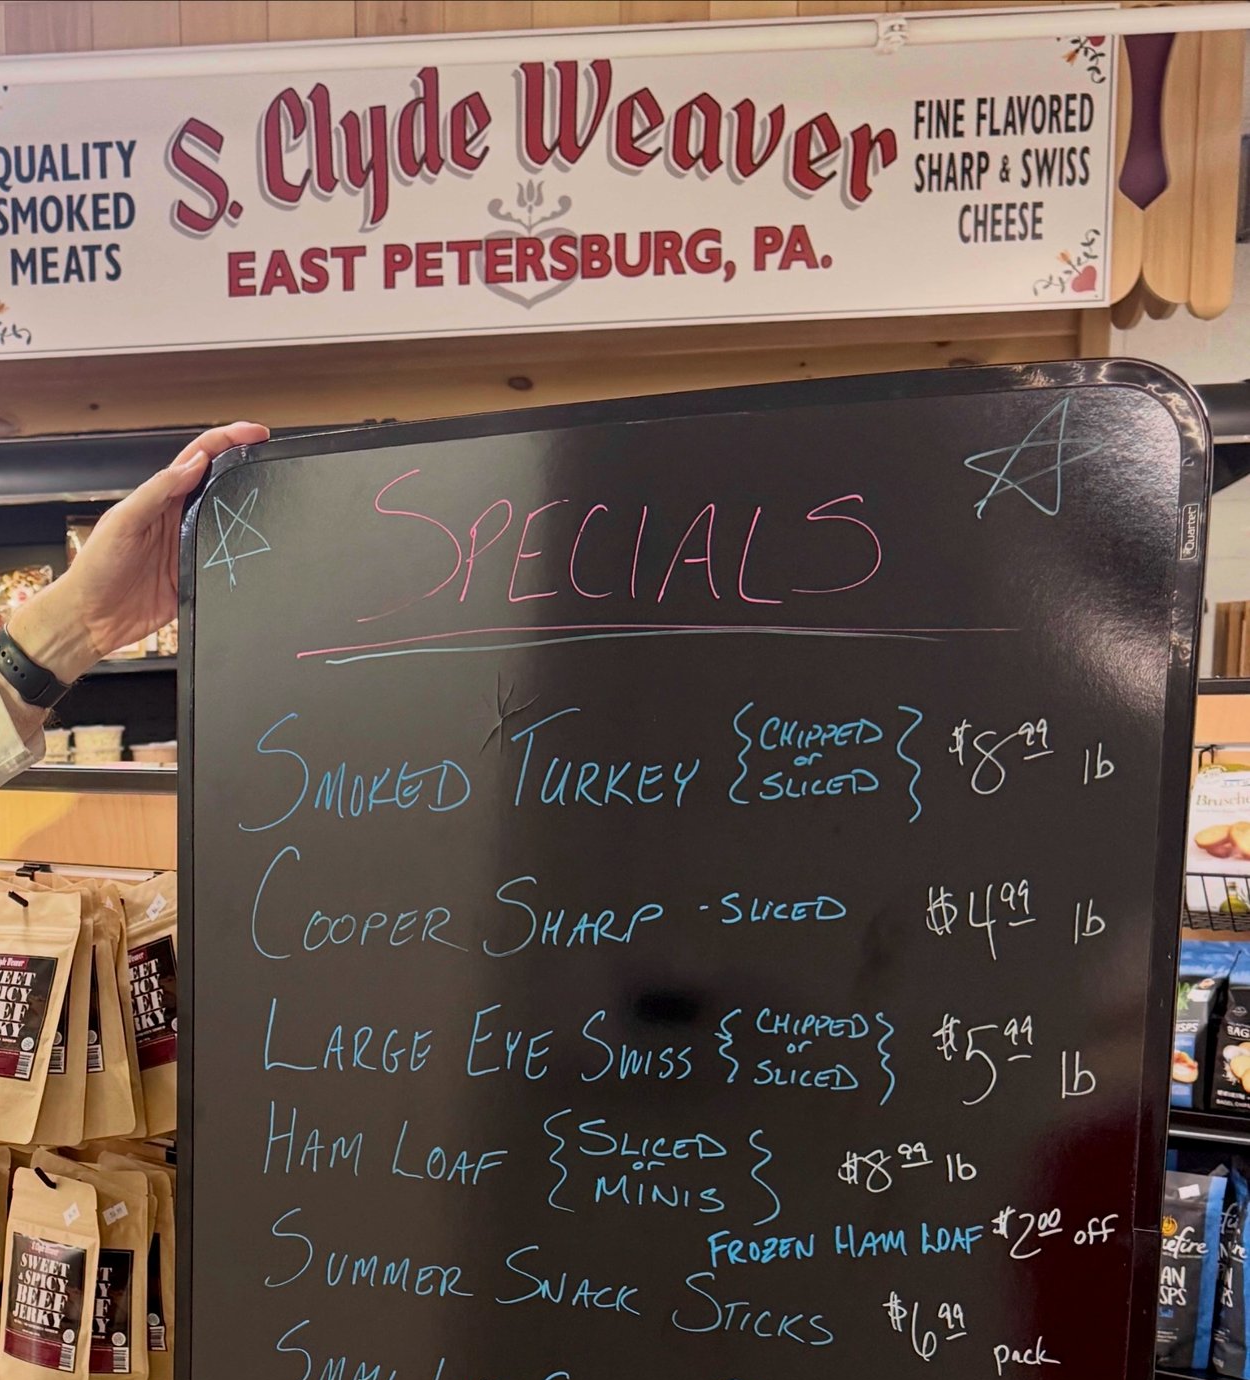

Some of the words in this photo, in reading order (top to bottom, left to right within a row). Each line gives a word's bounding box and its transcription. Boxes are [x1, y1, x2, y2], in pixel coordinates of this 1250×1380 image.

[914, 98, 966, 140] FINE
[975, 92, 1095, 138] FLAVORED
[169, 116, 244, 235] S.
[261, 65, 493, 227] Clyde
[518, 58, 899, 203] Weaver
[914, 151, 991, 193] SHARP
[998, 154, 1011, 184] &
[1020, 147, 1093, 188] SWISS
[957, 201, 1044, 244] CHEESE
[10, 243, 123, 287] MEATS
[227, 245, 367, 298] EAST
[383, 228, 737, 291] PETERSBURG,
[753, 224, 834, 272] PA.
[357, 469, 882, 622] SPECIALS
[759, 716, 884, 751] CHIPPED
[238, 712, 471, 832] SMOKED
[511, 708, 699, 807] TURKEY
[793, 750, 823, 767] or
[759, 768, 880, 800] SLICED
[252, 845, 469, 959] COOPER
[482, 875, 664, 958] SHARP
[264, 998, 433, 1074] LARGE
[467, 1004, 554, 1081] EYE
[581, 1010, 693, 1083] SWISS
[756, 1007, 870, 1038] CHIPPED
[1226, 1025, 1250, 1039] BAG
[786, 1040, 813, 1055] or
[754, 1060, 859, 1091] SLICED
[263, 1100, 364, 1177] HAM
[391, 1120, 509, 1186] LOAF
[578, 1118, 728, 1160] SLICED
[632, 1160, 666, 1172] or
[595, 1174, 726, 1213] MINIS
[706, 1229, 816, 1268] FROZEN
[835, 1224, 908, 1259] HAM
[921, 1222, 985, 1256] LOAF
[1074, 1213, 1119, 1246] off
[20, 1252, 71, 1278] SWEET
[23, 1269, 69, 1294] SPICY
[264, 1207, 475, 1298] SUMMER
[495, 1245, 641, 1317] SNACK
[671, 1271, 835, 1347] STICKS
[12, 1302, 66, 1329] JERKY
[17, 1282, 69, 1313] BEEF
[993, 1336, 1062, 1376] pack
